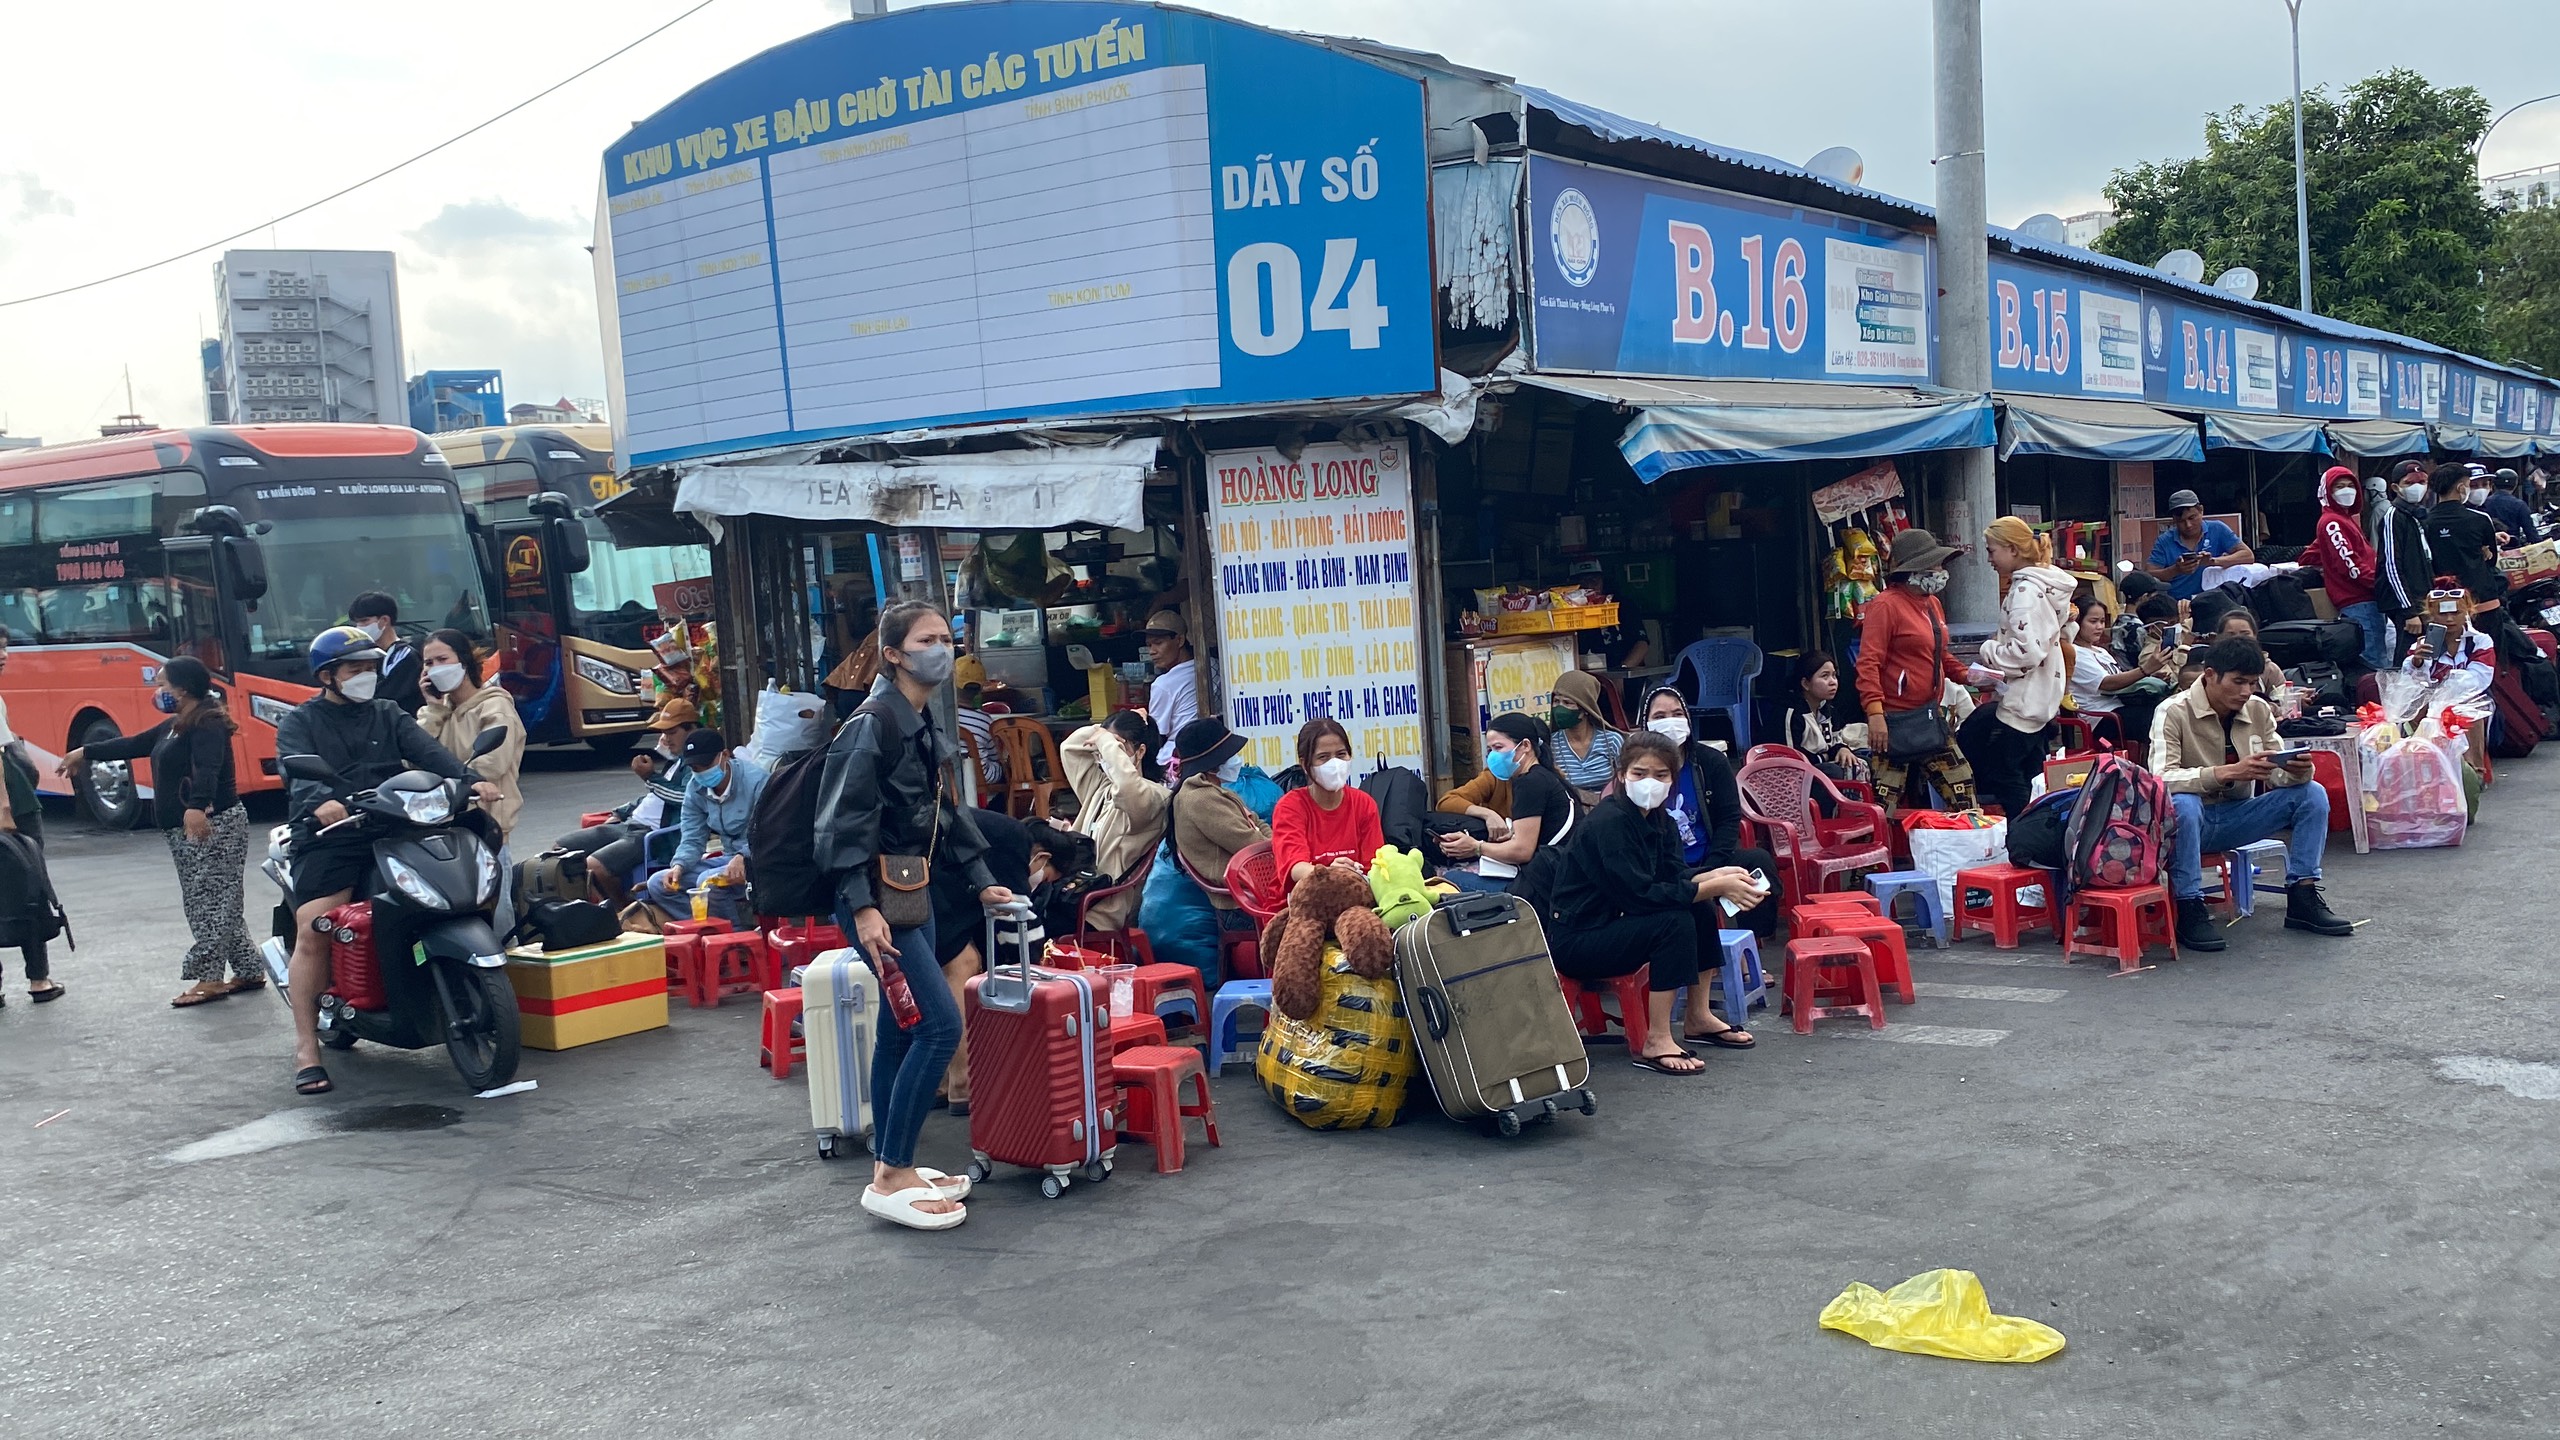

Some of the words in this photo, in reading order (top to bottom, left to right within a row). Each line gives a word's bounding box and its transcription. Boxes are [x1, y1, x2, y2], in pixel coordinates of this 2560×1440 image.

[623, 143, 673, 185] KHU
[676, 127, 728, 169] VỰC
[732, 115, 769, 154] XE
[774, 98, 831, 144] ĐẬU
[837, 76, 897, 127] CHỜ
[903, 66, 953, 111] TÀI
[960, 52, 1026, 99] CÁC
[1033, 17, 1146, 84] TUYẾN
[1222, 153, 1306, 210] DÃY
[1321, 137, 1380, 202] SỐ
[1103, 282, 1131, 299] TUM
[1227, 237, 1389, 357] 04
[1668, 219, 1809, 354] B.16
[1996, 279, 2070, 376] B.15
[2182, 320, 2230, 394] B.14
[2305, 346, 2343, 405] B.13
[803, 480, 851, 506] TEA
[912, 484, 964, 511] TEA
[1219, 455, 1306, 506] HOÀNG
[1311, 458, 1379, 499] LONG
[1220, 517, 1237, 553] HÀ
[1240, 515, 1261, 558] NỘI
[1271, 510, 1292, 549] HẢI
[1295, 510, 1333, 549] PHÒNG
[1343, 504, 1365, 544] HẢI
[1367, 506, 1406, 542] DƯƠNG
[1223, 555, 1260, 600] QUẢNG
[1262, 560, 1287, 593] NINH
[1296, 553, 1319, 590] HÒA
[1321, 551, 1347, 589] BÌNH
[1355, 554, 1381, 587] NAM
[1383, 552, 1409, 589] ĐỊNH
[1226, 597, 1249, 641] BẮC
[1252, 606, 1284, 639] GIANG
[1293, 596, 1329, 640] QUẢNG
[1332, 601, 1350, 637] TRỊ
[1359, 593, 1384, 631] THÁI
[1387, 591, 1412, 629] BÌNH
[1230, 651, 1262, 690] LẠNG
[1265, 646, 1291, 682] SƠN
[1301, 642, 1320, 679] MỸ
[1325, 640, 1355, 678] ĐÌNH
[1365, 637, 1390, 675] LÀO
[1393, 640, 1415, 672] CAI
[1232, 691, 1261, 729] VĨNH
[1263, 688, 1293, 726] PHÚC
[1338, 689, 1353, 720] AN
[1363, 681, 1380, 718] HÀ
[1383, 683, 1418, 716] GIANG
